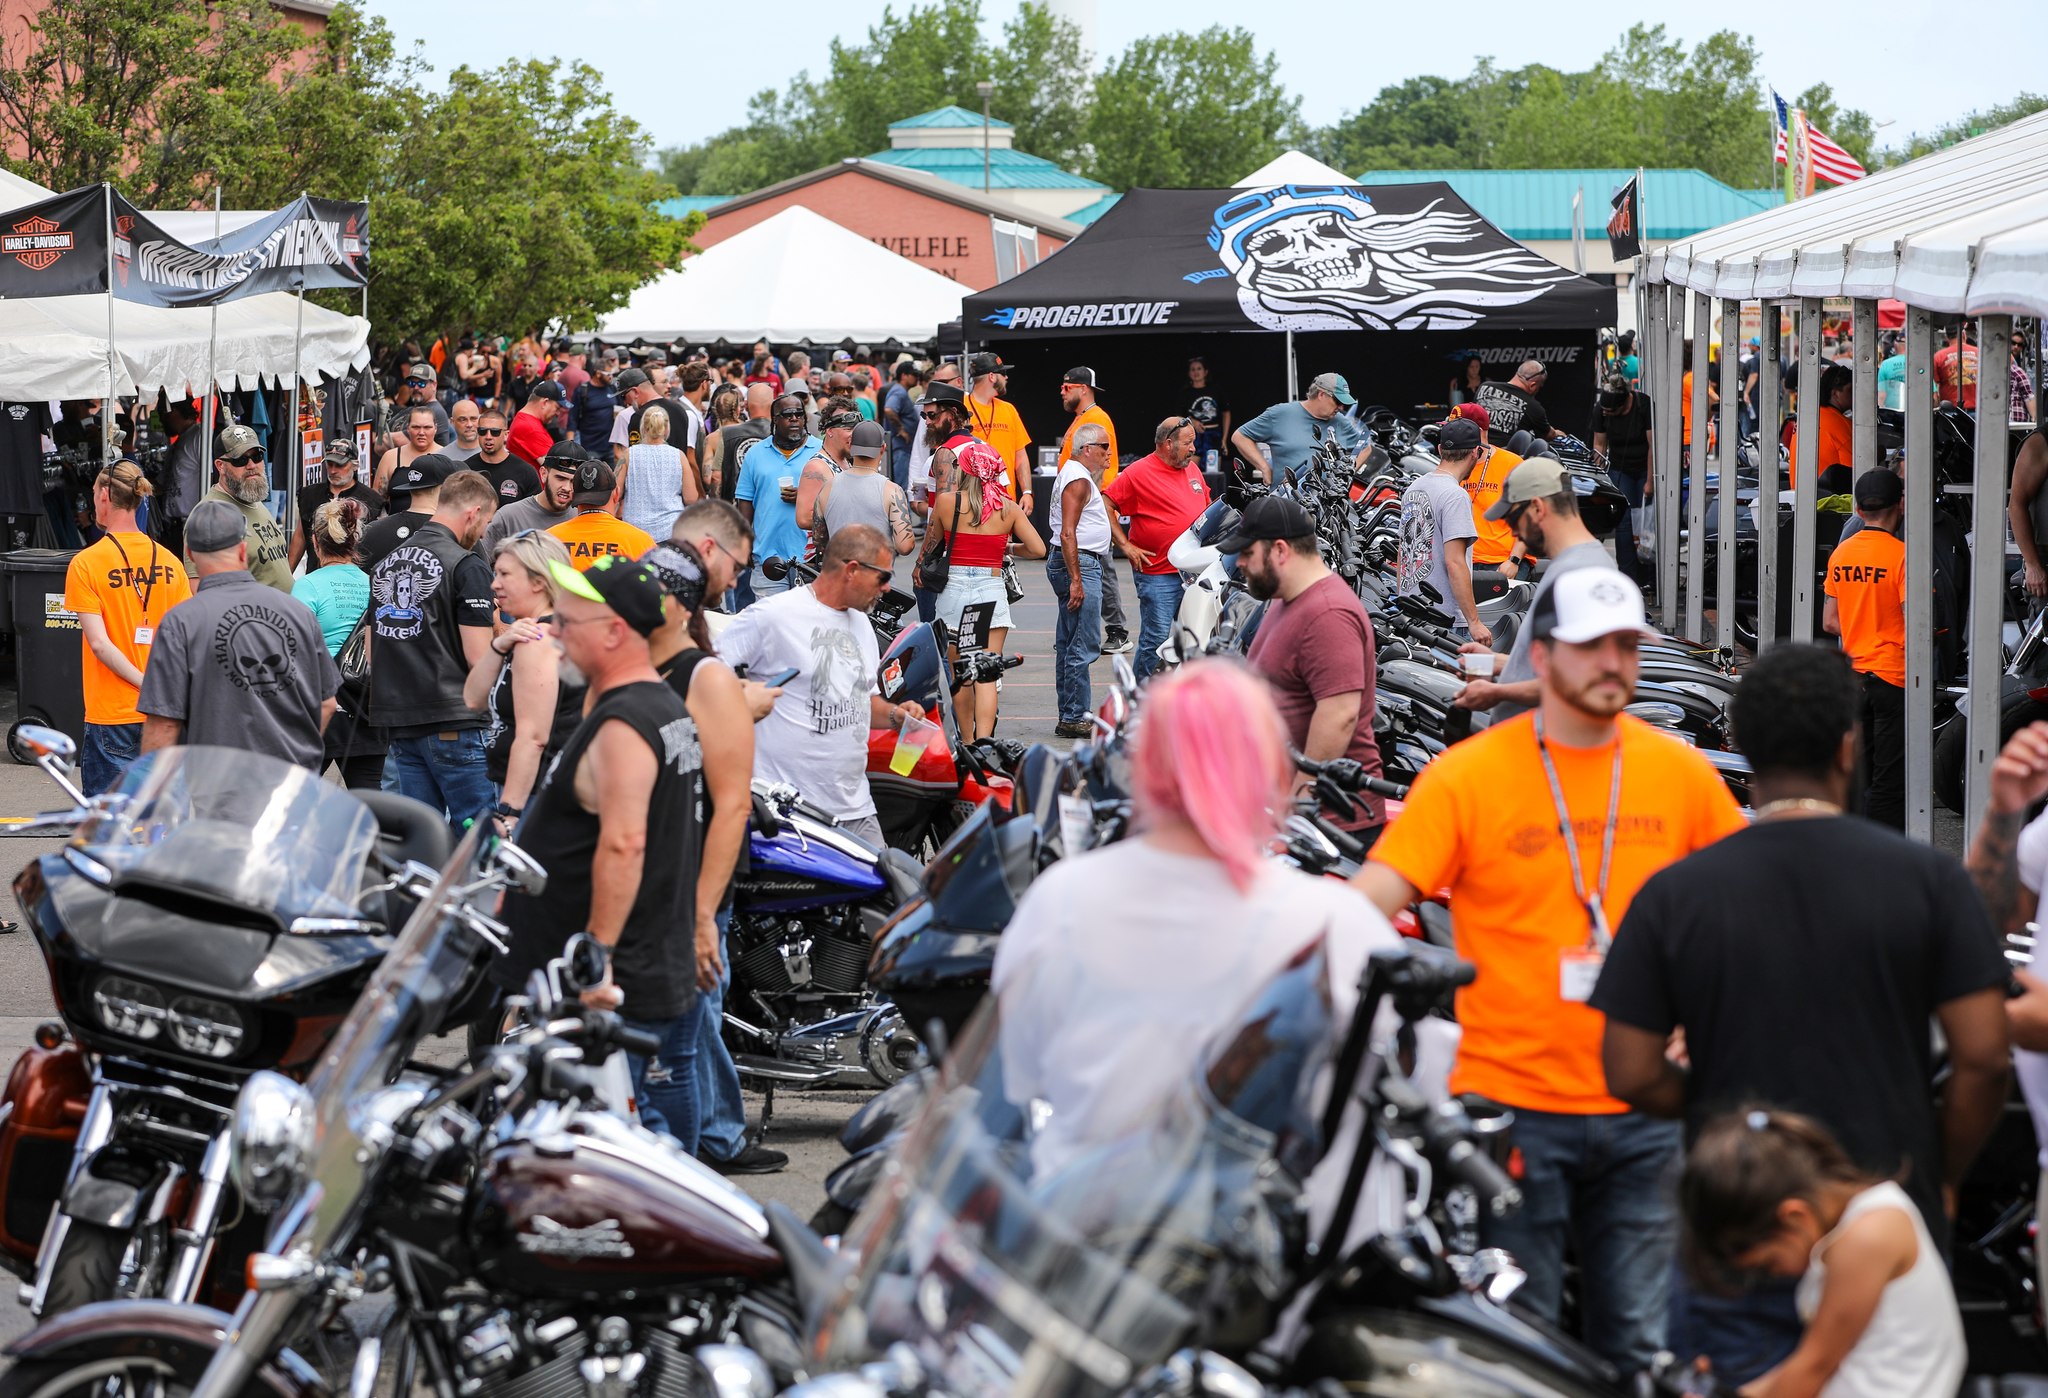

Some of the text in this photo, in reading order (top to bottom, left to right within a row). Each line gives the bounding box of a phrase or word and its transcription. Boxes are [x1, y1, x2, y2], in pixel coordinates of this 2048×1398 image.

[19, 220, 54, 233] MOTOR
[5, 234, 70, 250] HARLEY-DAVIDSON
[21, 251, 56, 267] CYCLES
[1009, 302, 1175, 330] PROGRESSIVE
[1488, 409, 1525, 431] IDSON
[563, 542, 619, 557] TAFF
[374, 547, 444, 579] FLAWLESS
[108, 566, 175, 589] STAFF
[1833, 566, 1888, 584] STAFF
[962, 611, 980, 623] NEW
[214, 604, 297, 664] HARLEY-DAVIDSON
[376, 620, 423, 640] BIKERZ
[960, 623, 974, 635] FOR
[959, 634, 976, 648] 2024
[805, 697, 859, 717] Harley
